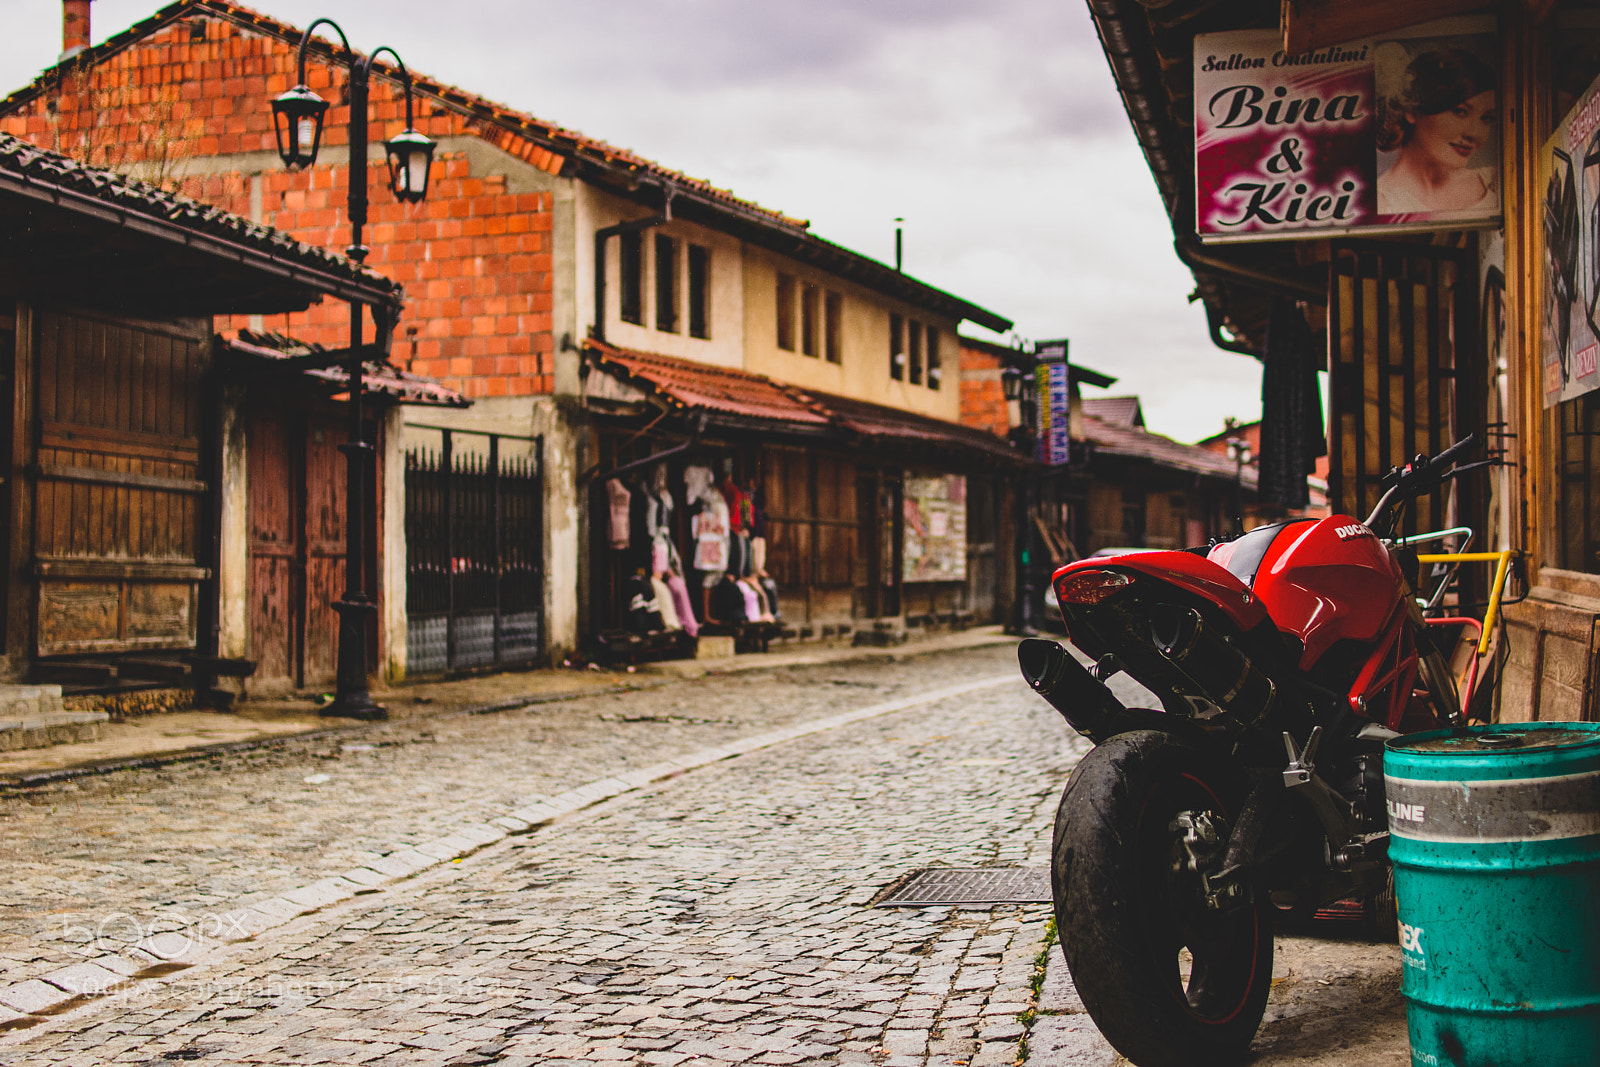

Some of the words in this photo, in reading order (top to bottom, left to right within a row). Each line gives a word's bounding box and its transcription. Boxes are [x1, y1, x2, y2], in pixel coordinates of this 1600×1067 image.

[1201, 53, 1265, 72] Sallon
[1272, 45, 1368, 67] Ondulimi
[1208, 85, 1368, 128] Bina
[1266, 138, 1303, 174] &
[1217, 180, 1355, 226] Kici
